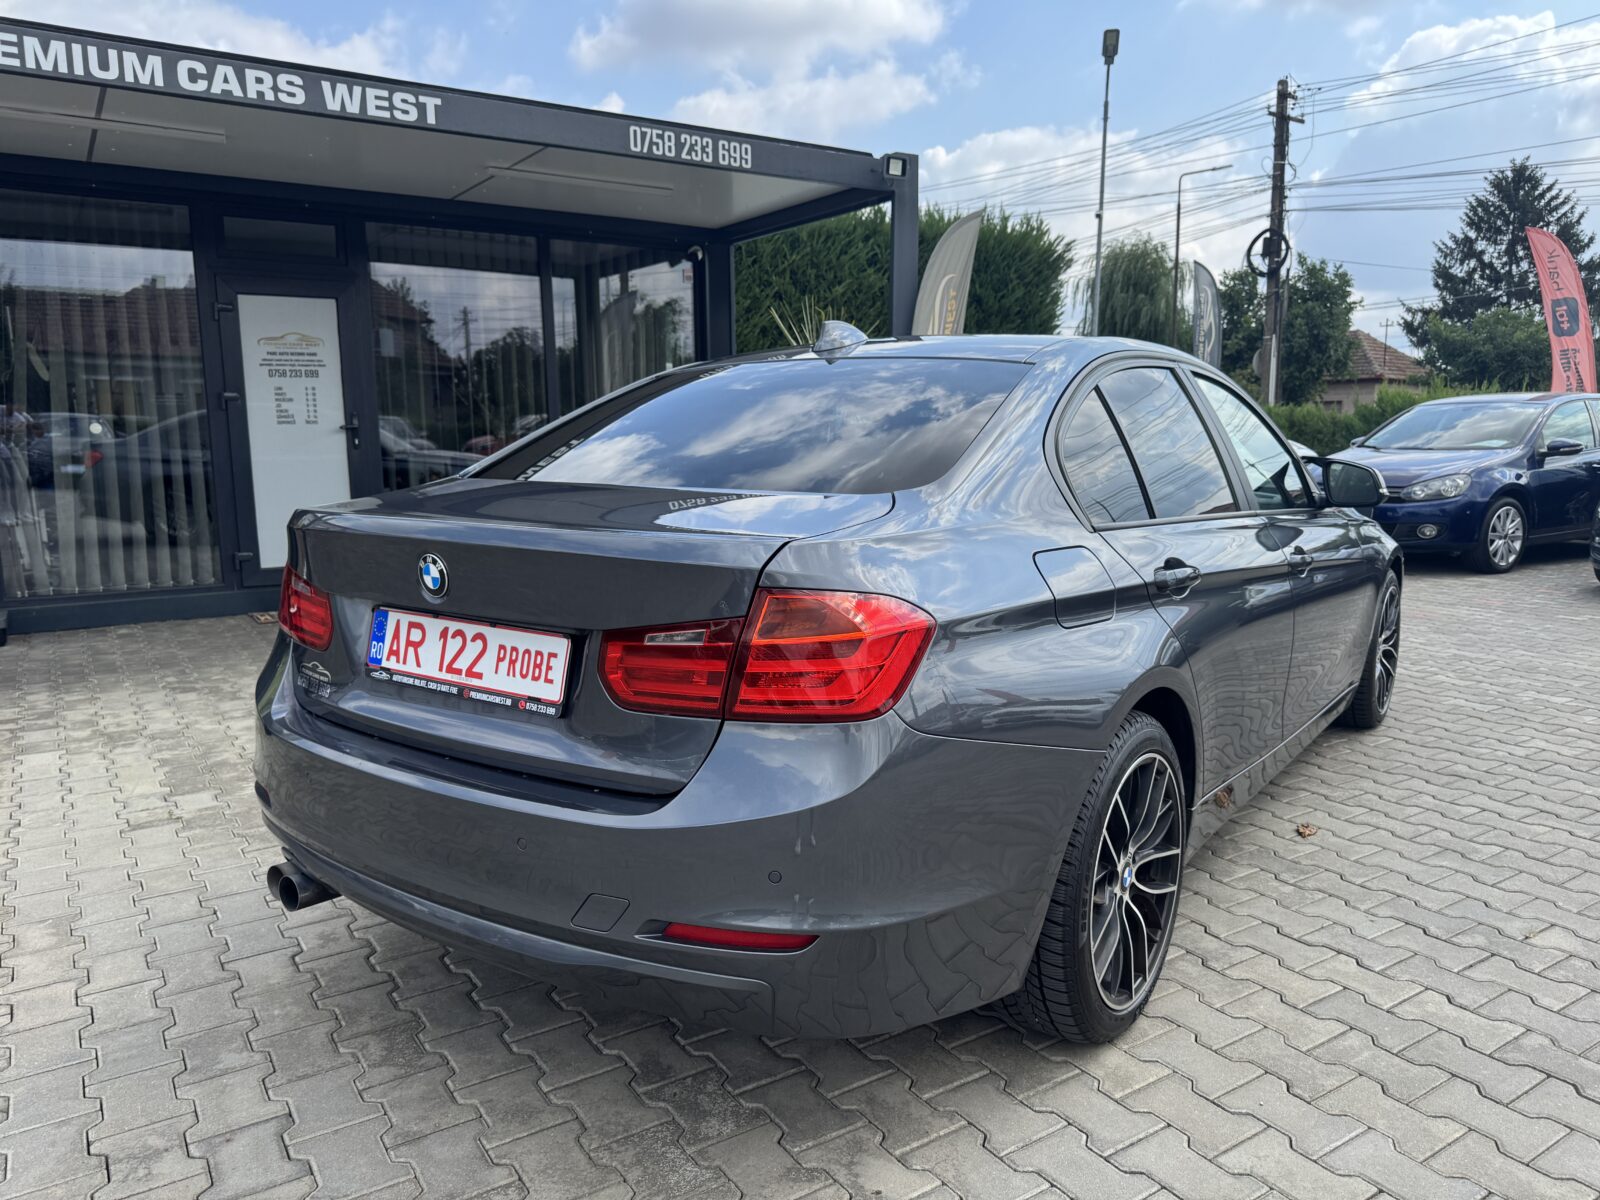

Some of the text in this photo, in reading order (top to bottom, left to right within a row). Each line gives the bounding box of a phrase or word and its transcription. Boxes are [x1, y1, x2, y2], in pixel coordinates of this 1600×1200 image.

[0, 32, 442, 125] EMIUM CARS WEST
[629, 125, 752, 169] 0758 233 699
[268, 368, 319, 378] 0758 233 699
[370, 641, 384, 659] RO
[386, 618, 559, 685] AR 122 PROBE
[537, 704, 546, 714] 233
